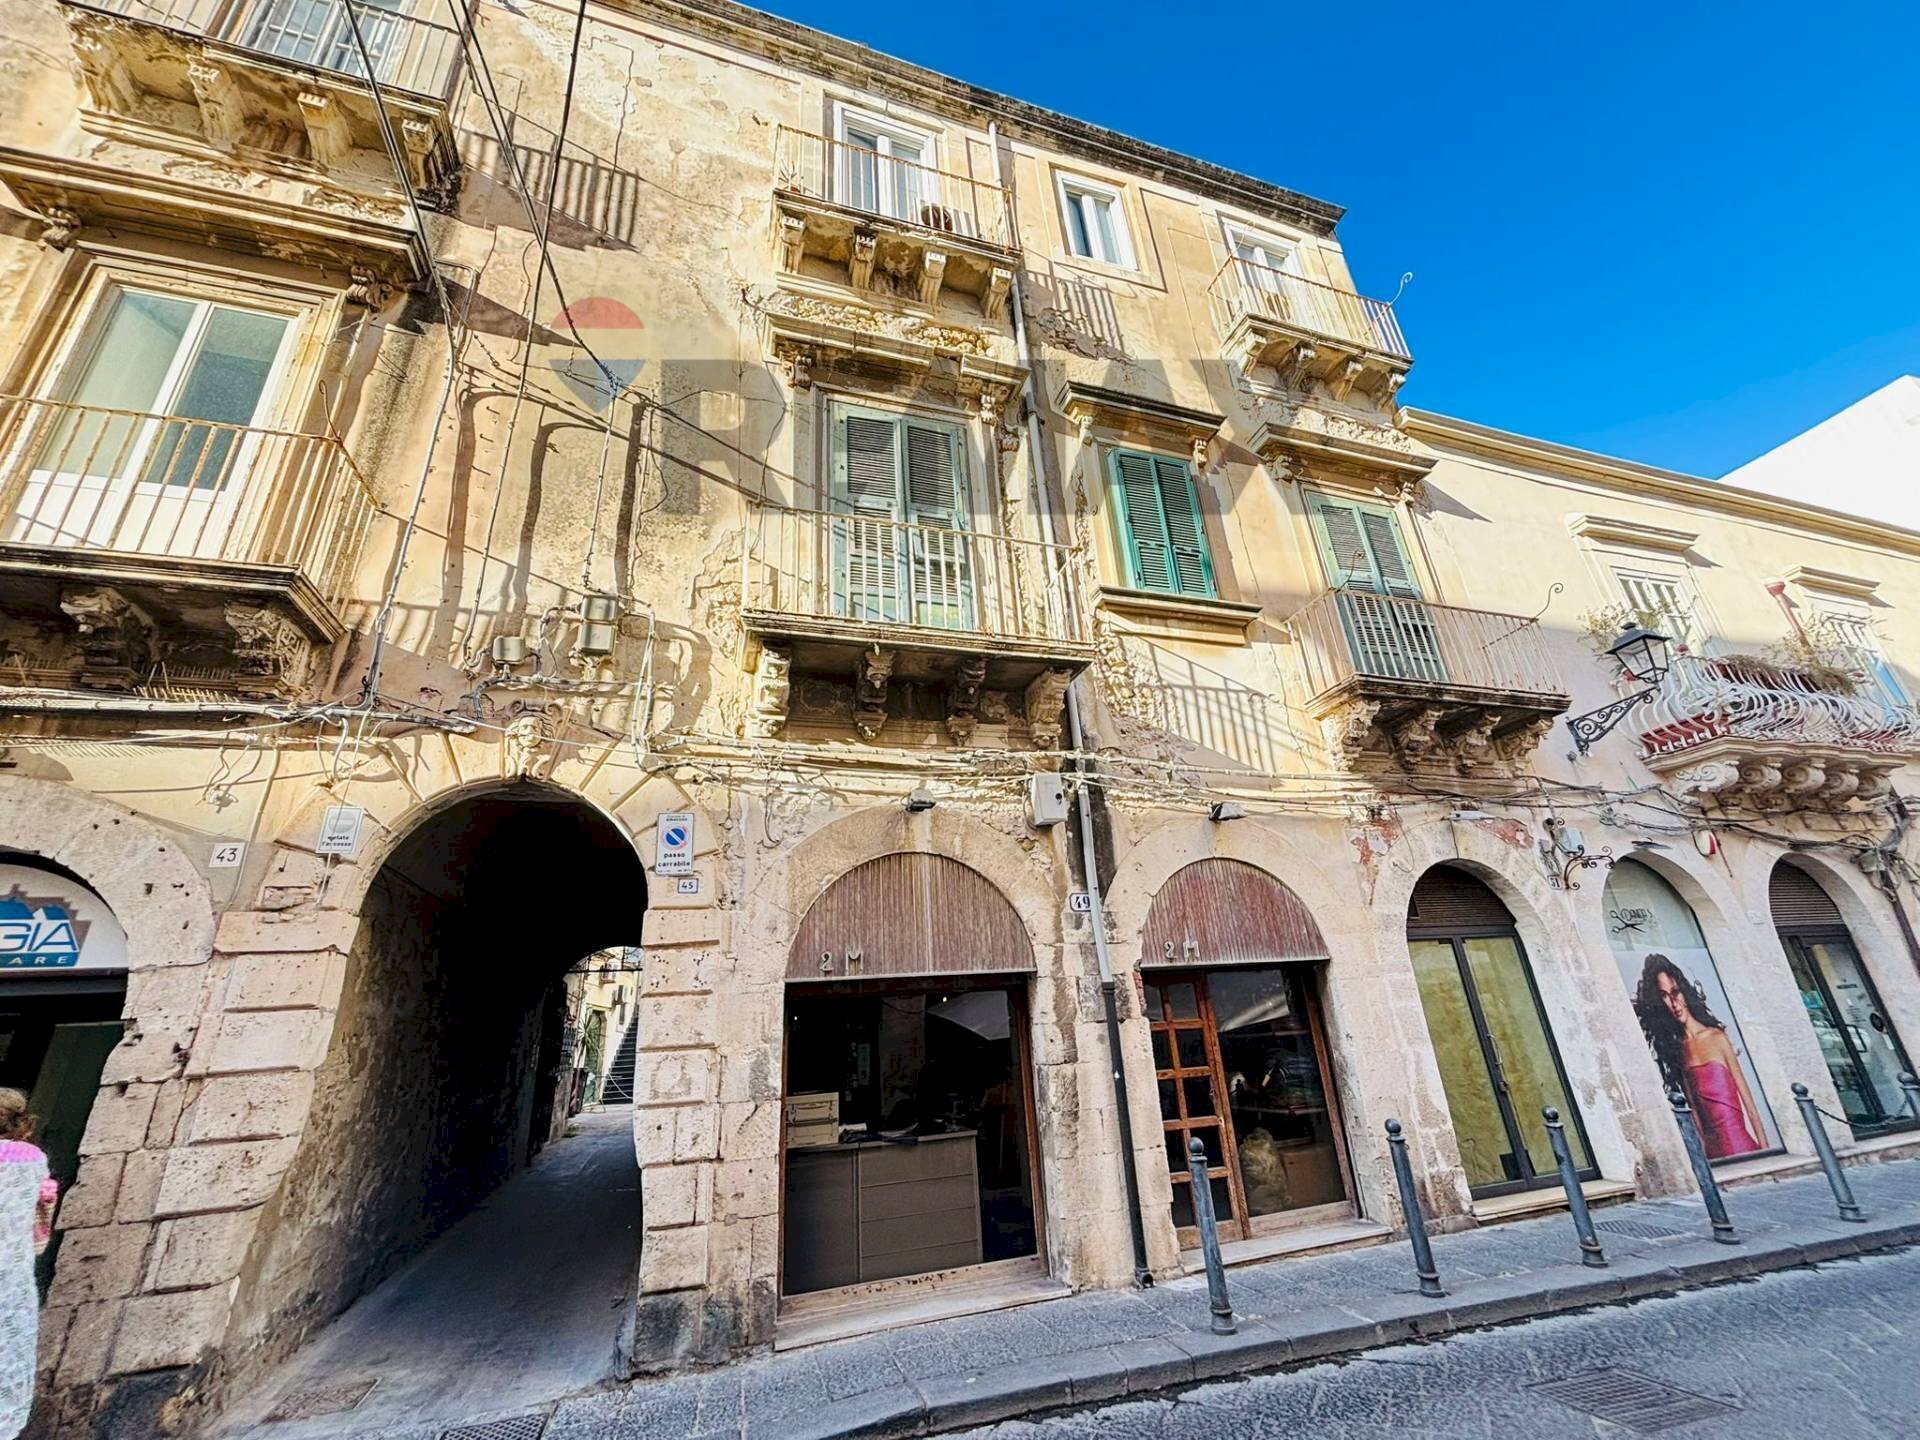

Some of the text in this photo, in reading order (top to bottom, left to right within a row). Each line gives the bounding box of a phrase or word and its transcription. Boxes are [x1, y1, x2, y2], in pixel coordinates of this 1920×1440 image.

[216, 847, 238, 862] 43
[681, 881, 694, 890] 45
[1074, 895, 1090, 908] 49
